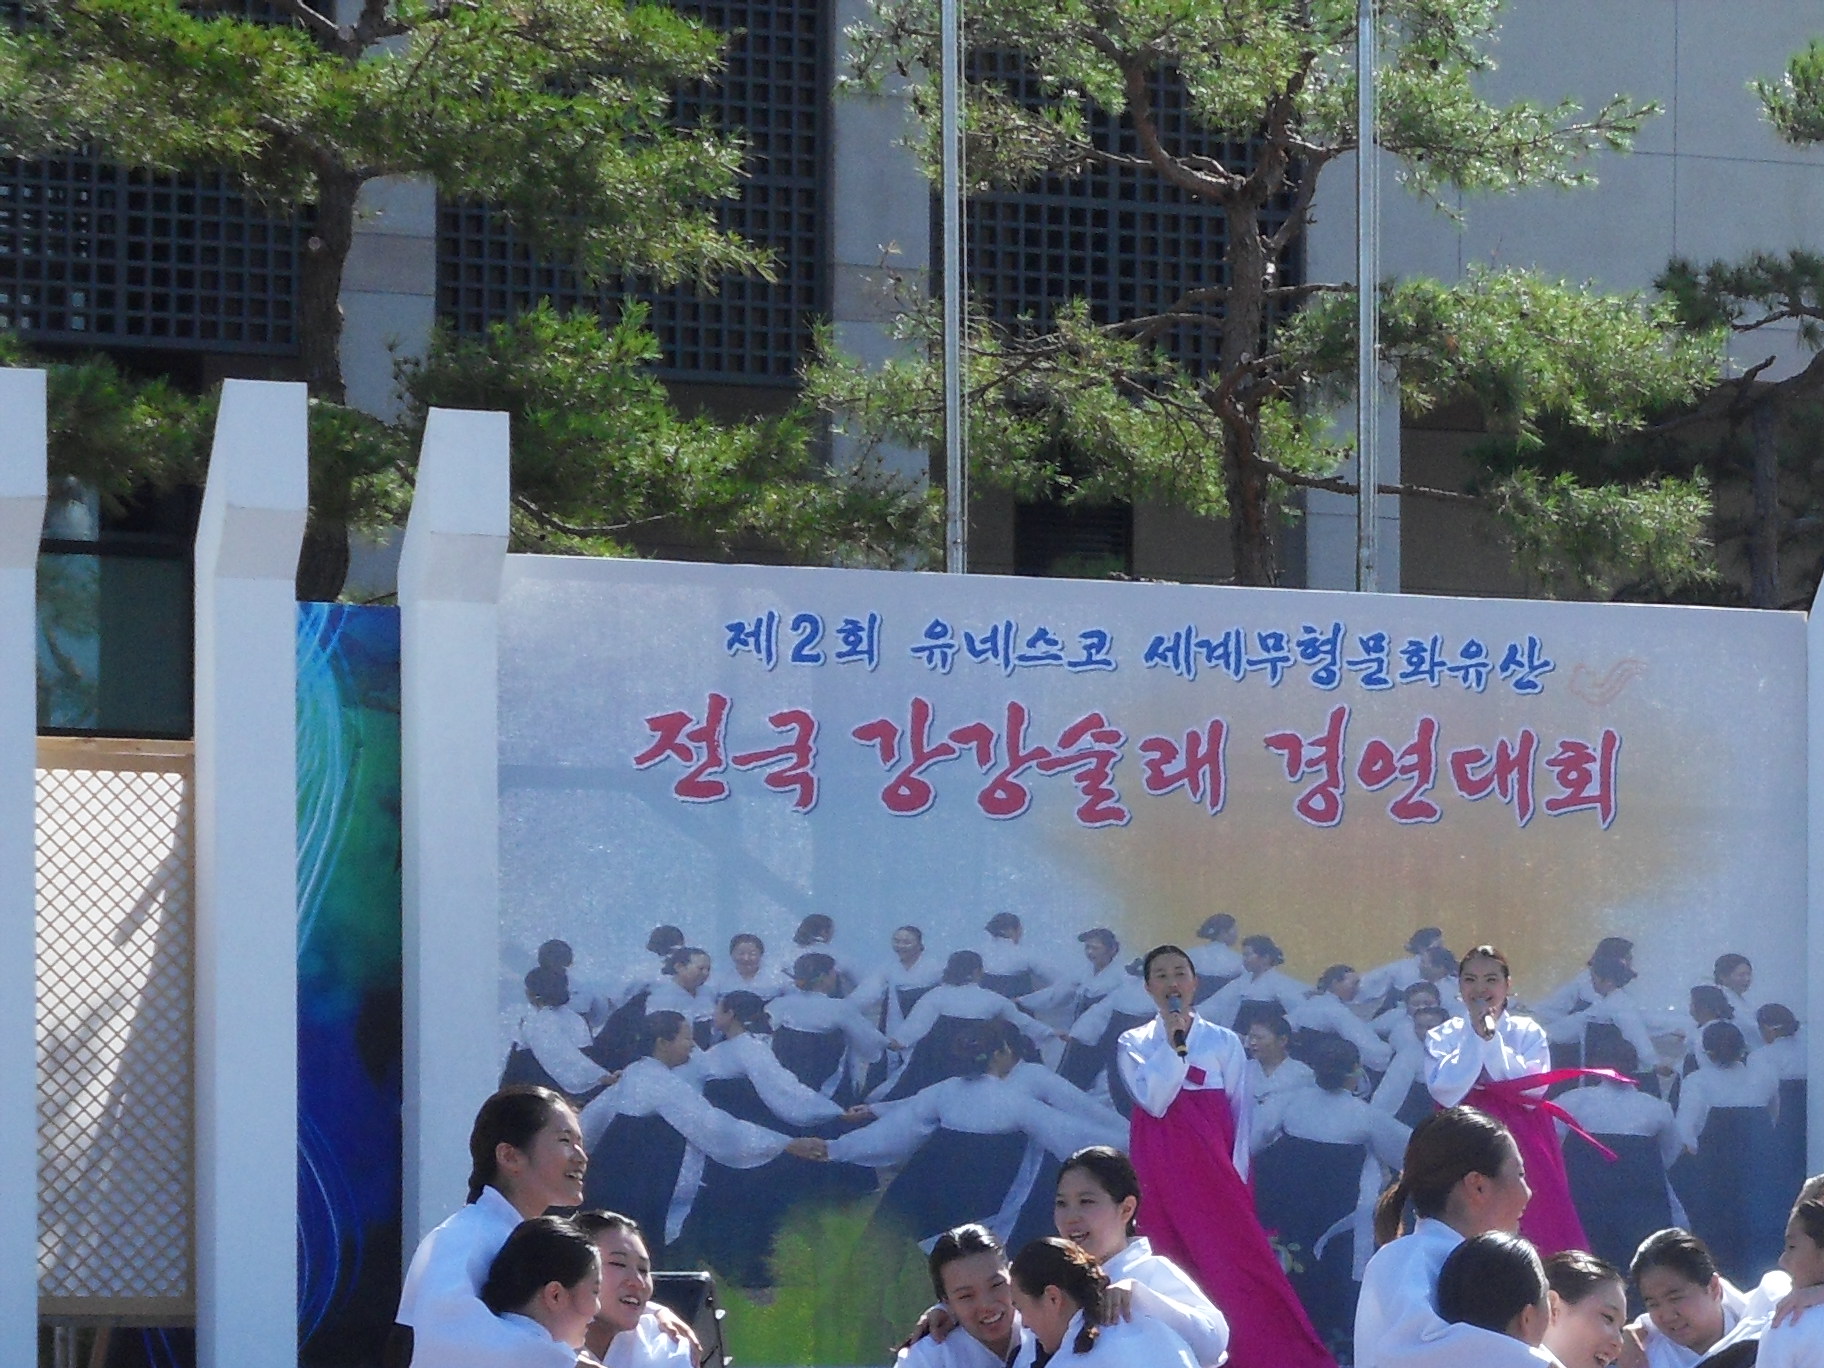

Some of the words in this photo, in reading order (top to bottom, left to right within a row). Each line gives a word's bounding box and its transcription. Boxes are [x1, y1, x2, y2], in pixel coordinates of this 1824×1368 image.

[724, 610, 882, 670] 제2회
[910, 617, 1117, 676] 유네스코
[1143, 621, 1556, 693] 세계무형문화유산
[633, 691, 820, 811] 전국
[851, 696, 1230, 826] 강강술래
[1263, 704, 1622, 829] 경연대회
